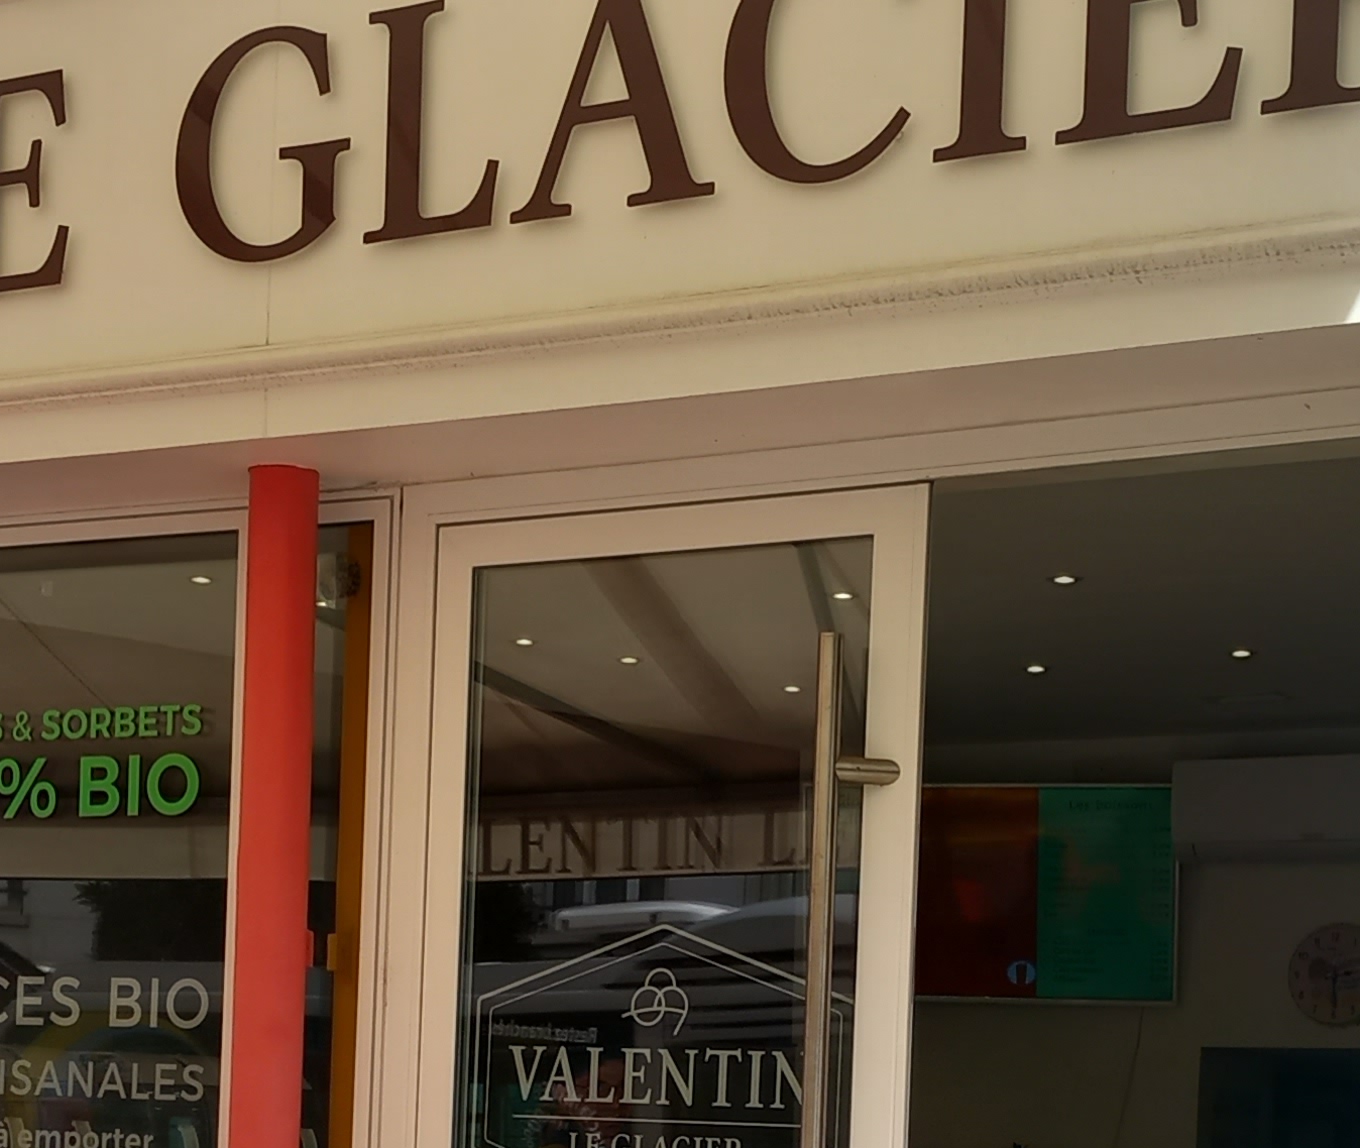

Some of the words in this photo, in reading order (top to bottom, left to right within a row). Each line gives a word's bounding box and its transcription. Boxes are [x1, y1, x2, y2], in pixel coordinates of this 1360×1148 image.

[12, 710, 32, 742] &
[40, 704, 202, 741] SORBETS
[78, 753, 200, 818] BIO
[108, 976, 210, 1029] BIO
[509, 1044, 804, 1110] VALENTIN
